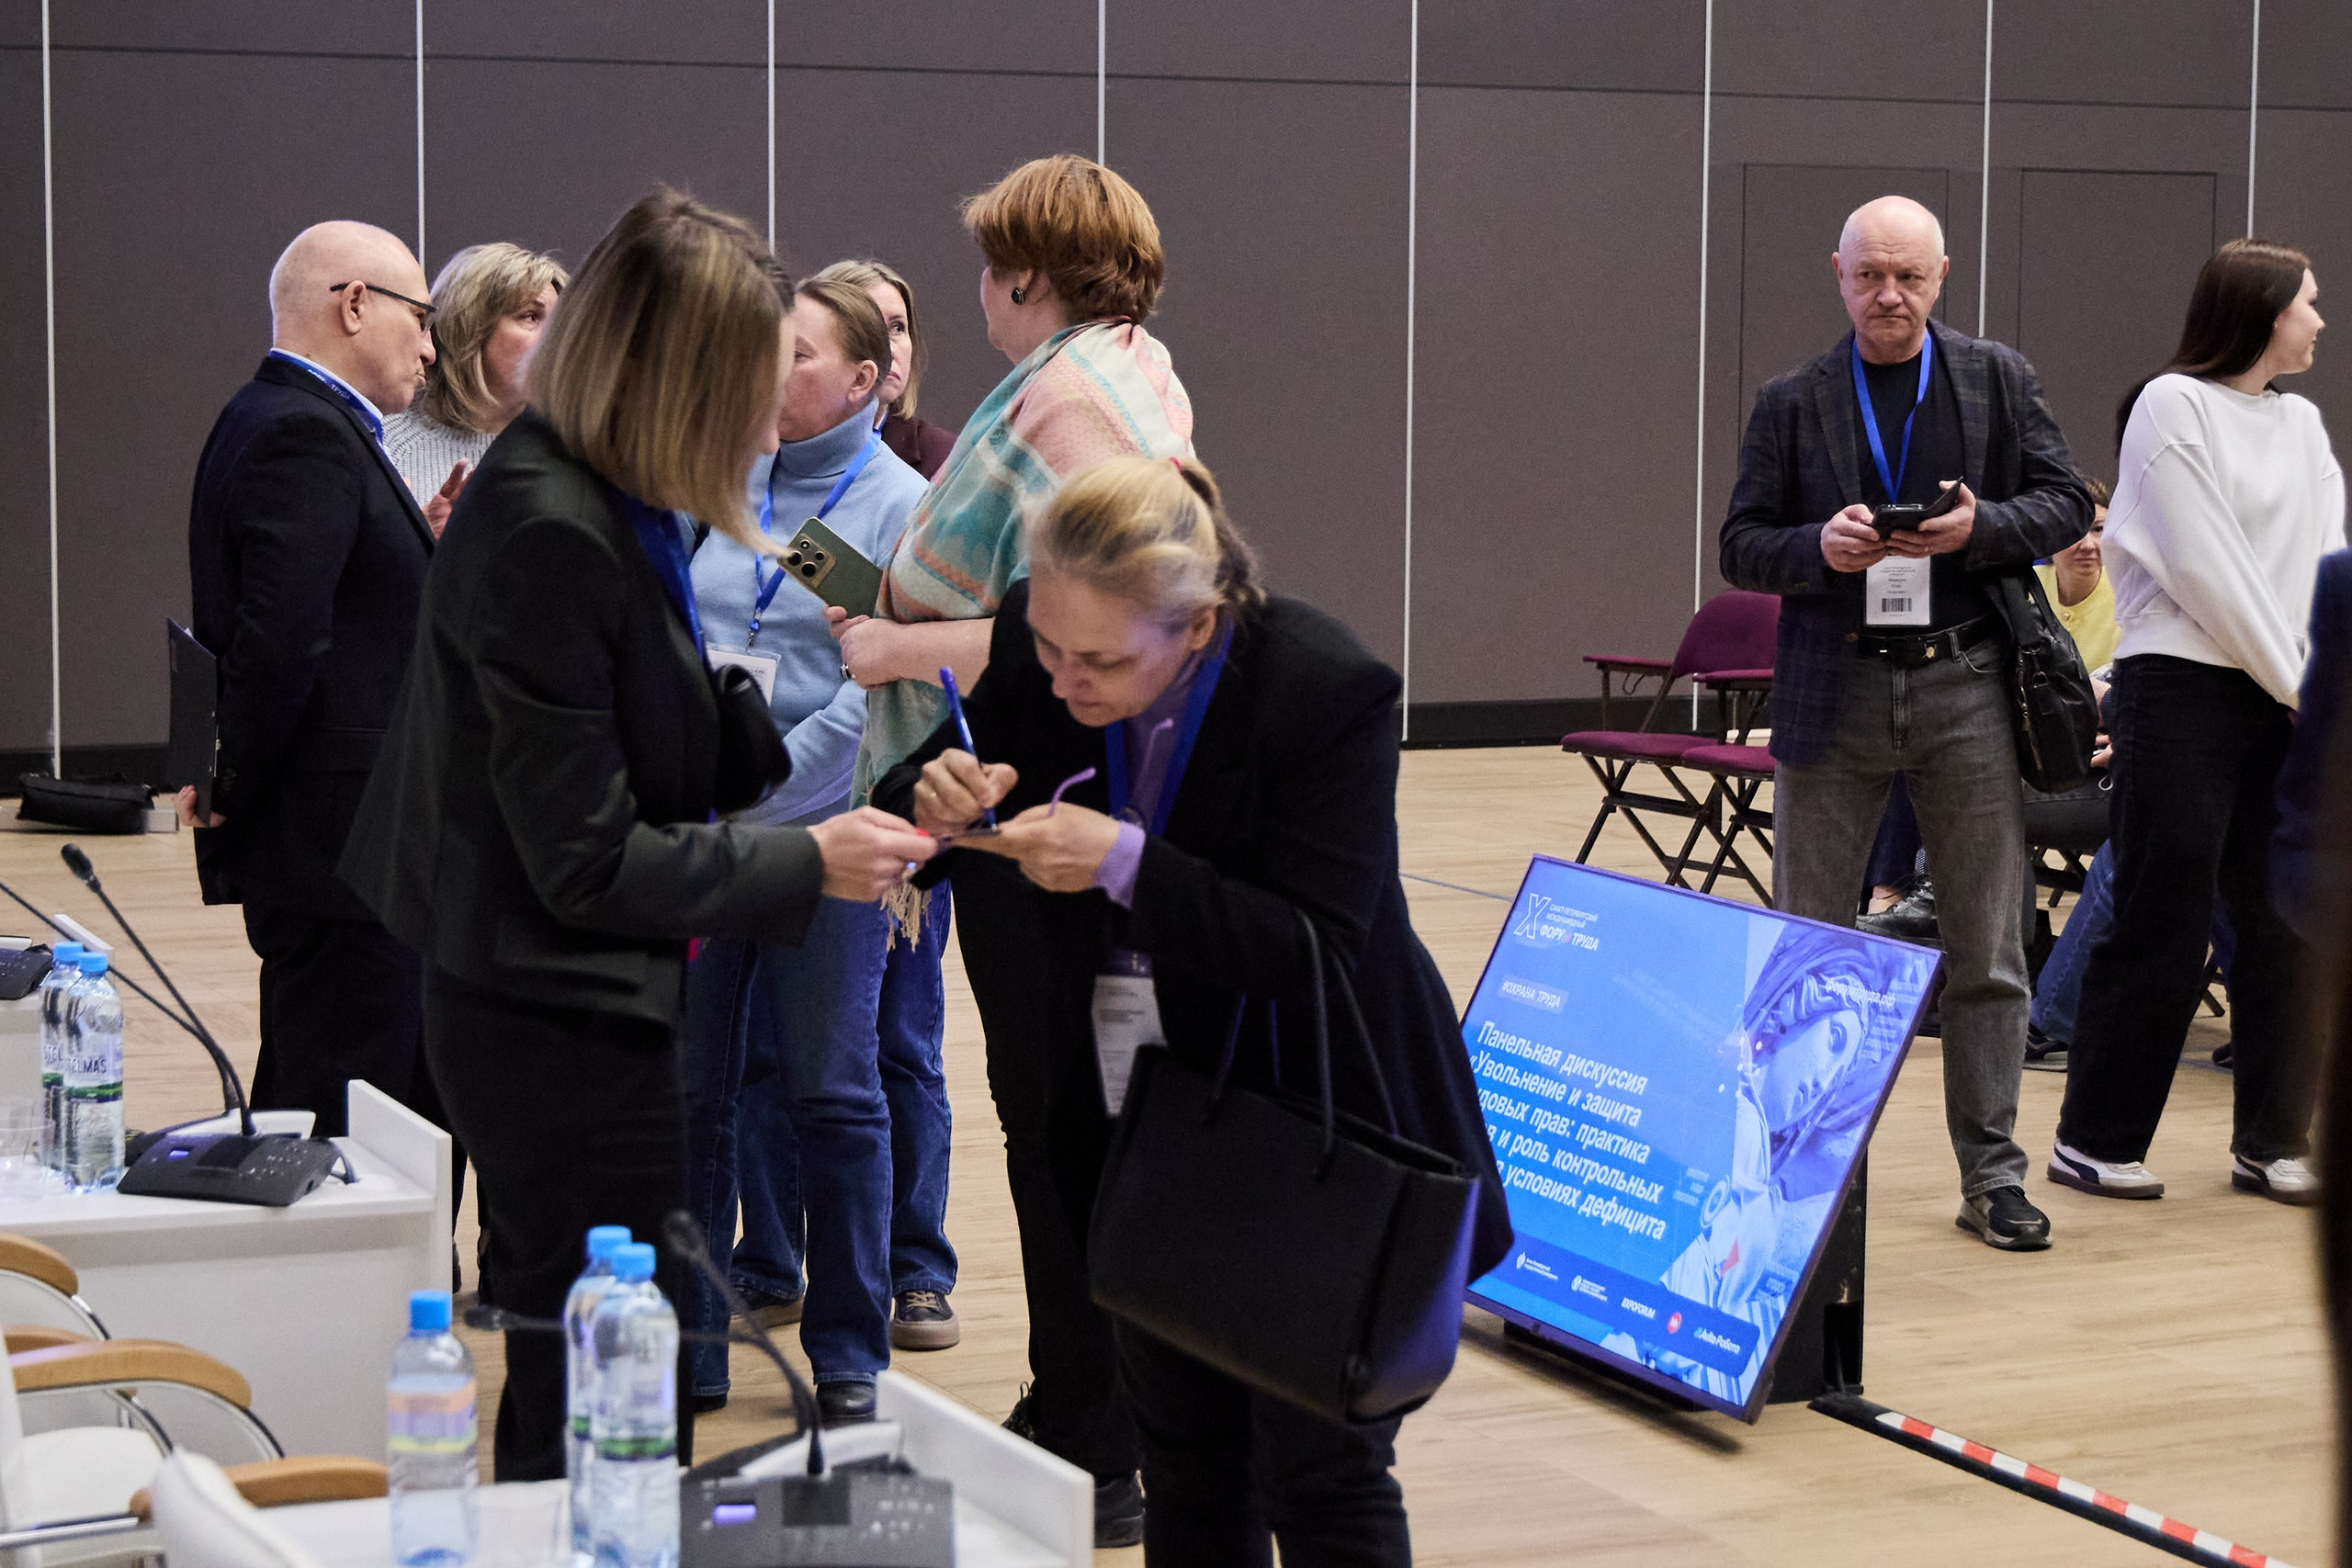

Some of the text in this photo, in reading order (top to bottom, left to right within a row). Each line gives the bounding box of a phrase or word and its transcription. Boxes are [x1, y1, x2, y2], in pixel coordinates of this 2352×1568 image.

[1571, 932, 1600, 952] ТРУДА
[1501, 980, 1561, 1009] #ОХРАНА ТРУДА
[1826, 979, 1895, 1008] форумтруда.рф
[1470, 1050, 1642, 1127] «Увольнение и защита
[1477, 1021, 1648, 1095] Панельная дискуссия
[1497, 1129, 1511, 1148] и
[1508, 1134, 1550, 1164] роль
[1552, 1148, 1664, 1204] контрольных
[1530, 1108, 1576, 1138] прав:
[1576, 1123, 1651, 1165] практика
[1502, 1164, 1582, 1208] условиях
[1577, 1193, 1667, 1240] дефицита
